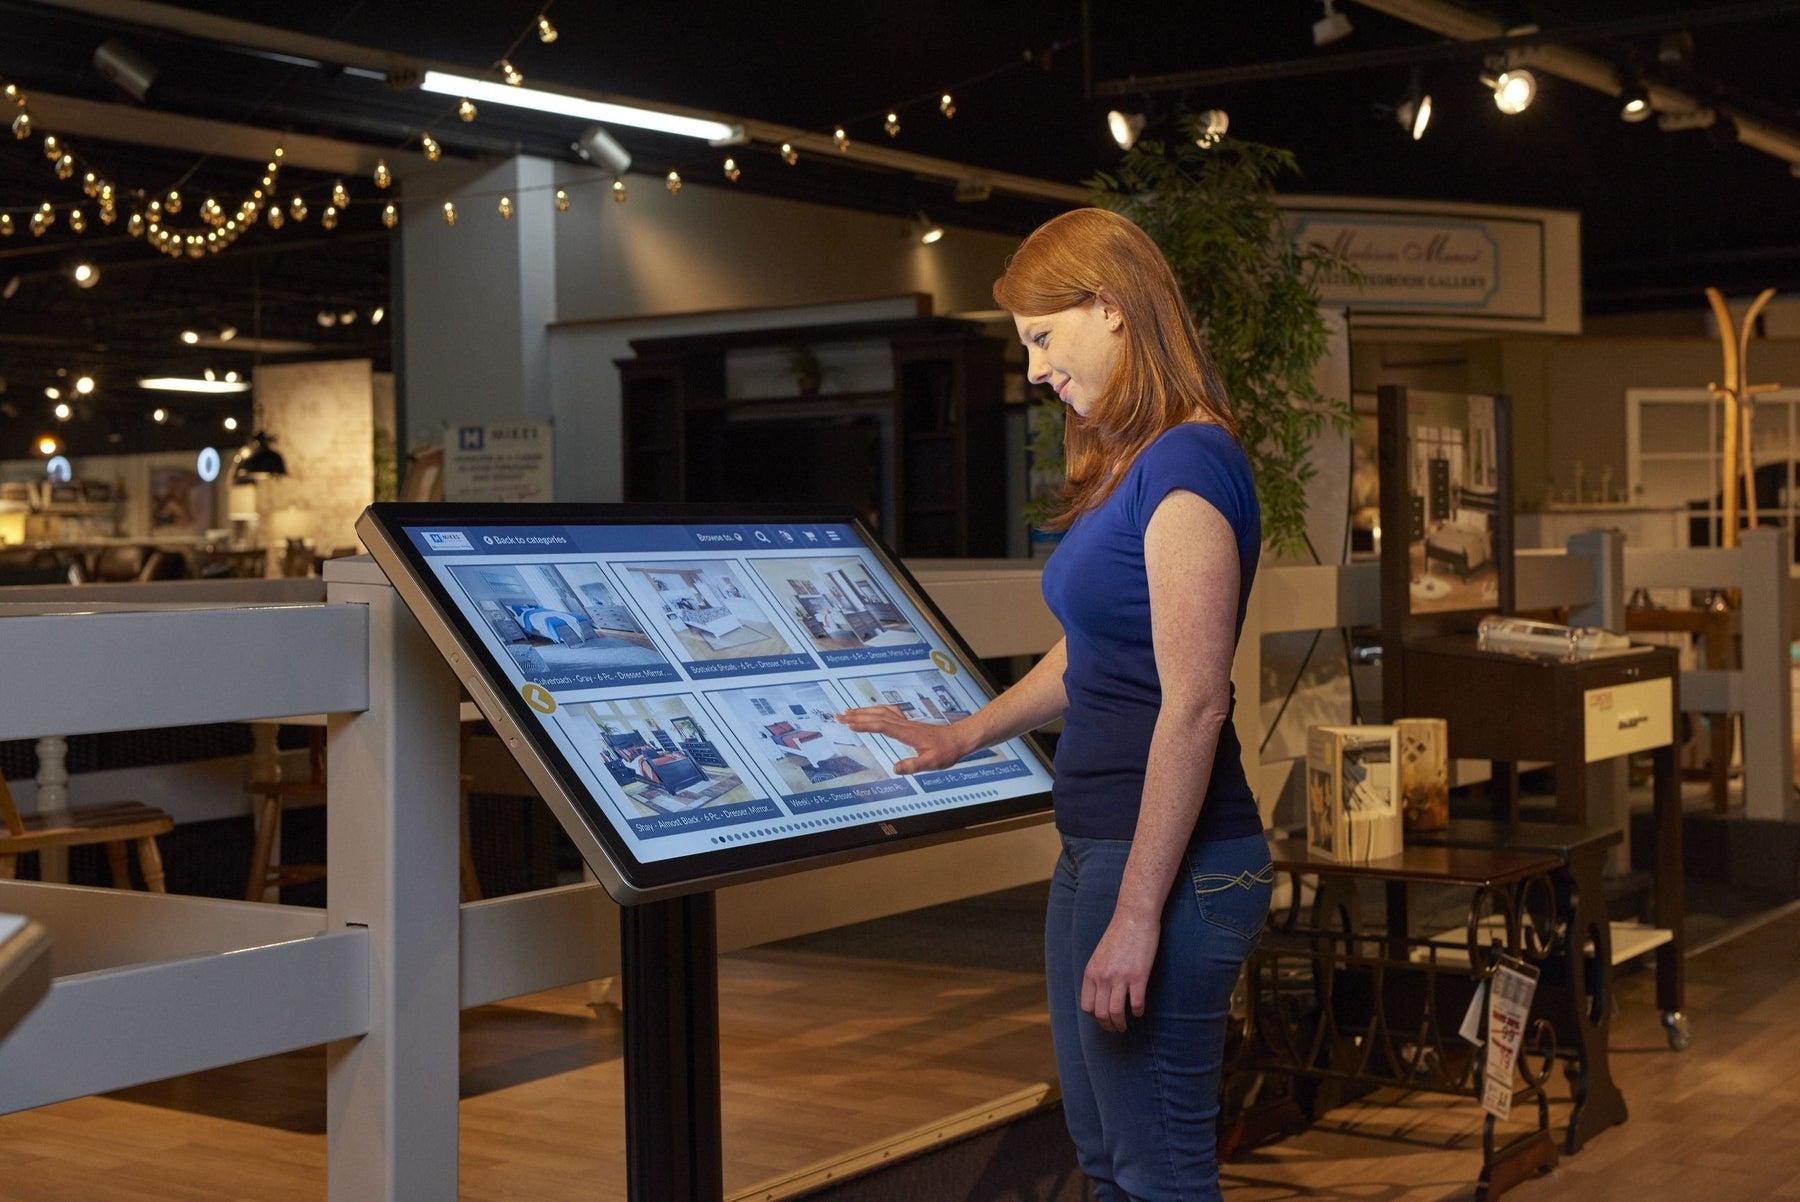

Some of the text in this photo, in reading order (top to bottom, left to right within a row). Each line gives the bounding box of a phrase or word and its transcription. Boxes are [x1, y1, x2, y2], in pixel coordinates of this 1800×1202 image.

[1428, 275, 1486, 289] GALLERY
[494, 535, 567, 546] Back to categories
[696, 533, 724, 541] Browse
[690, 664, 718, 674] Bostwick
[744, 661, 755, 669] Pc.
[757, 660, 782, 668] Dresser,
[533, 676, 572, 686] Culverbach
[575, 674, 593, 684] Gray
[597, 673, 602, 681] 6
[602, 672, 614, 681] Pc.
[617, 671, 645, 680] Dresser,
[818, 795, 829, 803] Pc.
[831, 791, 856, 801] Dresser,
[853, 788, 871, 797] Mirror
[635, 823, 655, 833] Shay
[658, 819, 682, 829] Almost
[682, 815, 701, 826] Black
[703, 813, 710, 822] 6
[709, 811, 721, 821] Pc.
[724, 808, 751, 818] Dresser,
